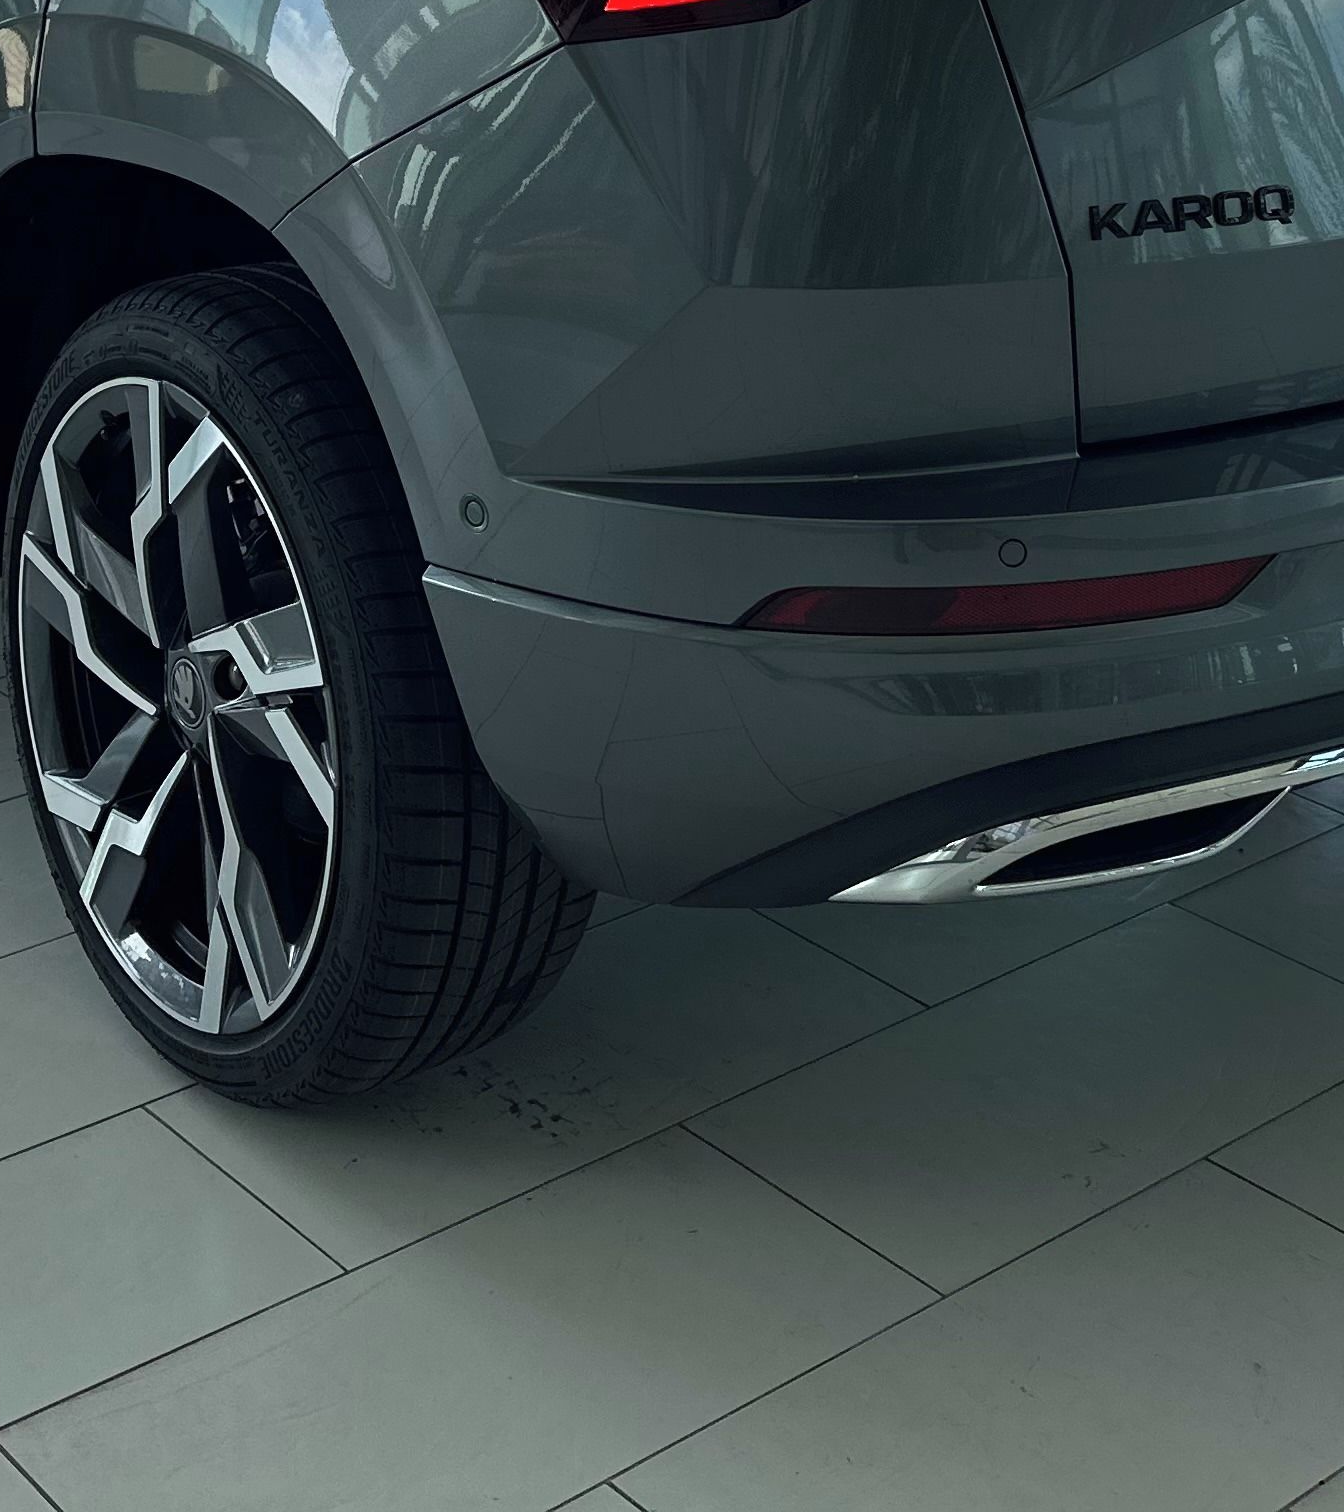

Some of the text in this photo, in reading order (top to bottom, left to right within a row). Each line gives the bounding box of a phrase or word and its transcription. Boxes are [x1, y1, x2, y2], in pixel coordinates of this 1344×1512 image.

[1088, 184, 1295, 241] KAROQ
[255, 410, 328, 559] TURANZA
[257, 944, 354, 1081] BRIDGESTONE
